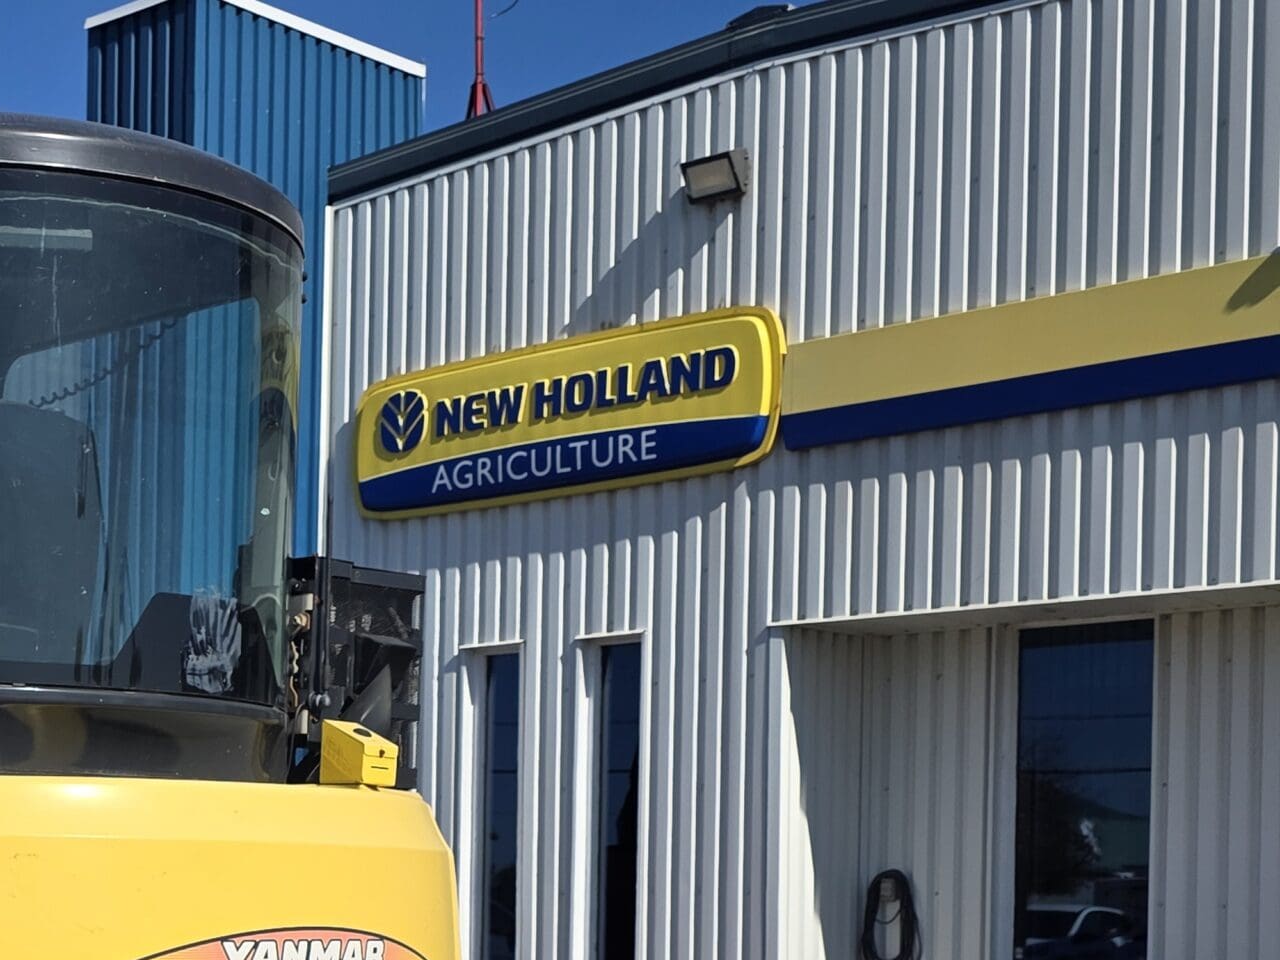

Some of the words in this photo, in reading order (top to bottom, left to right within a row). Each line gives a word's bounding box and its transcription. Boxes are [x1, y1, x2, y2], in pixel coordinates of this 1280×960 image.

[436, 383, 524, 438] NEW
[534, 346, 738, 421] HOLLAND
[431, 429, 658, 494] AGRICULTURE
